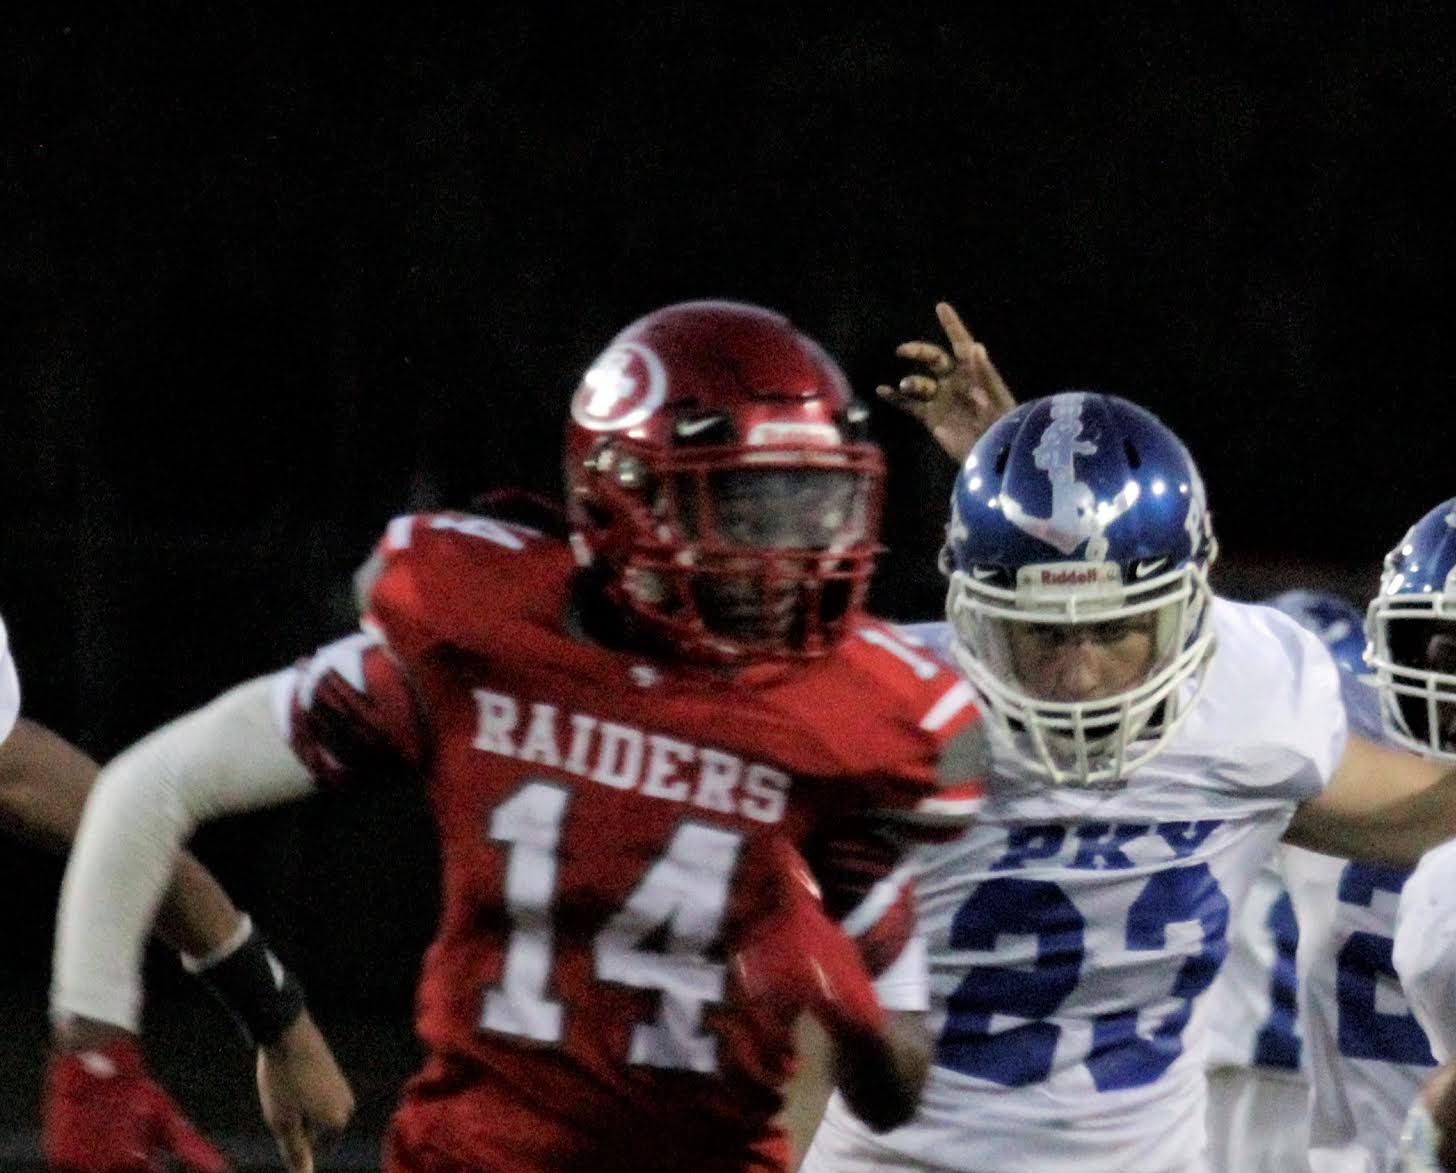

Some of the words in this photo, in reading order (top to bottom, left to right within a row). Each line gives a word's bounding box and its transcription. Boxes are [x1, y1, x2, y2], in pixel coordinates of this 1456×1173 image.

[473, 688, 792, 824] RAIDERS
[990, 819, 1227, 870] PKY
[479, 781, 743, 1073] 14
[936, 861, 1231, 1093] 23
